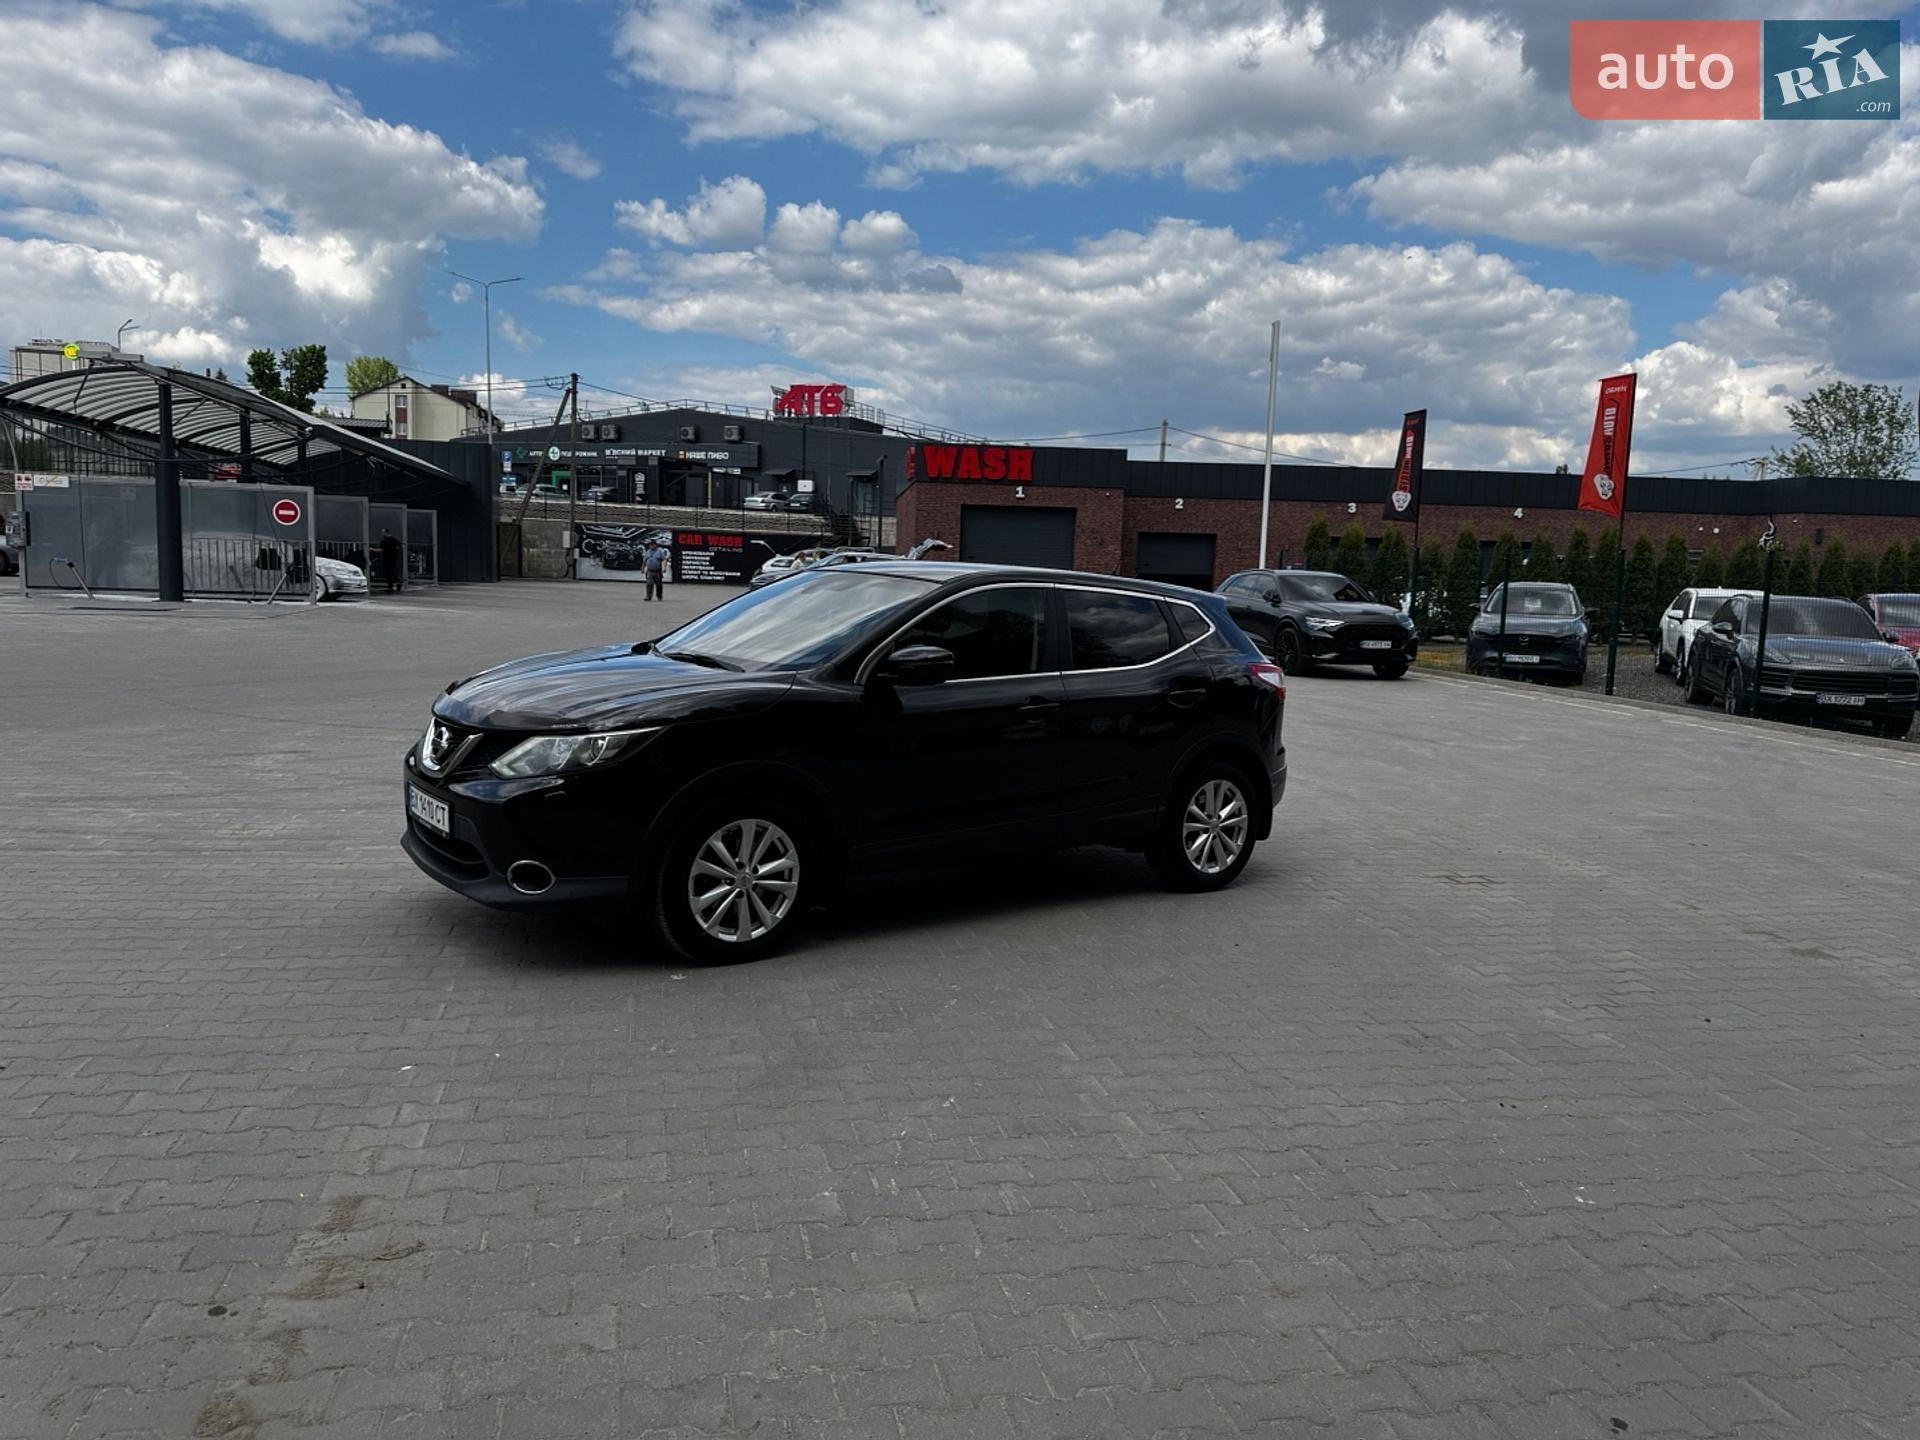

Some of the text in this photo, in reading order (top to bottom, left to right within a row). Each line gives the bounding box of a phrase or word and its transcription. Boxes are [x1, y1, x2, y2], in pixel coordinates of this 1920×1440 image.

[1603, 407, 1617, 436] AUTO
[707, 452, 730, 461] ПИВО
[923, 445, 1034, 481] WASH
[1016, 486, 1025, 498] 1
[1174, 498, 1184, 510] 2
[1348, 502, 1358, 514] 3
[1513, 508, 1524, 519] 4
[679, 534, 743, 547] CAR WASH
